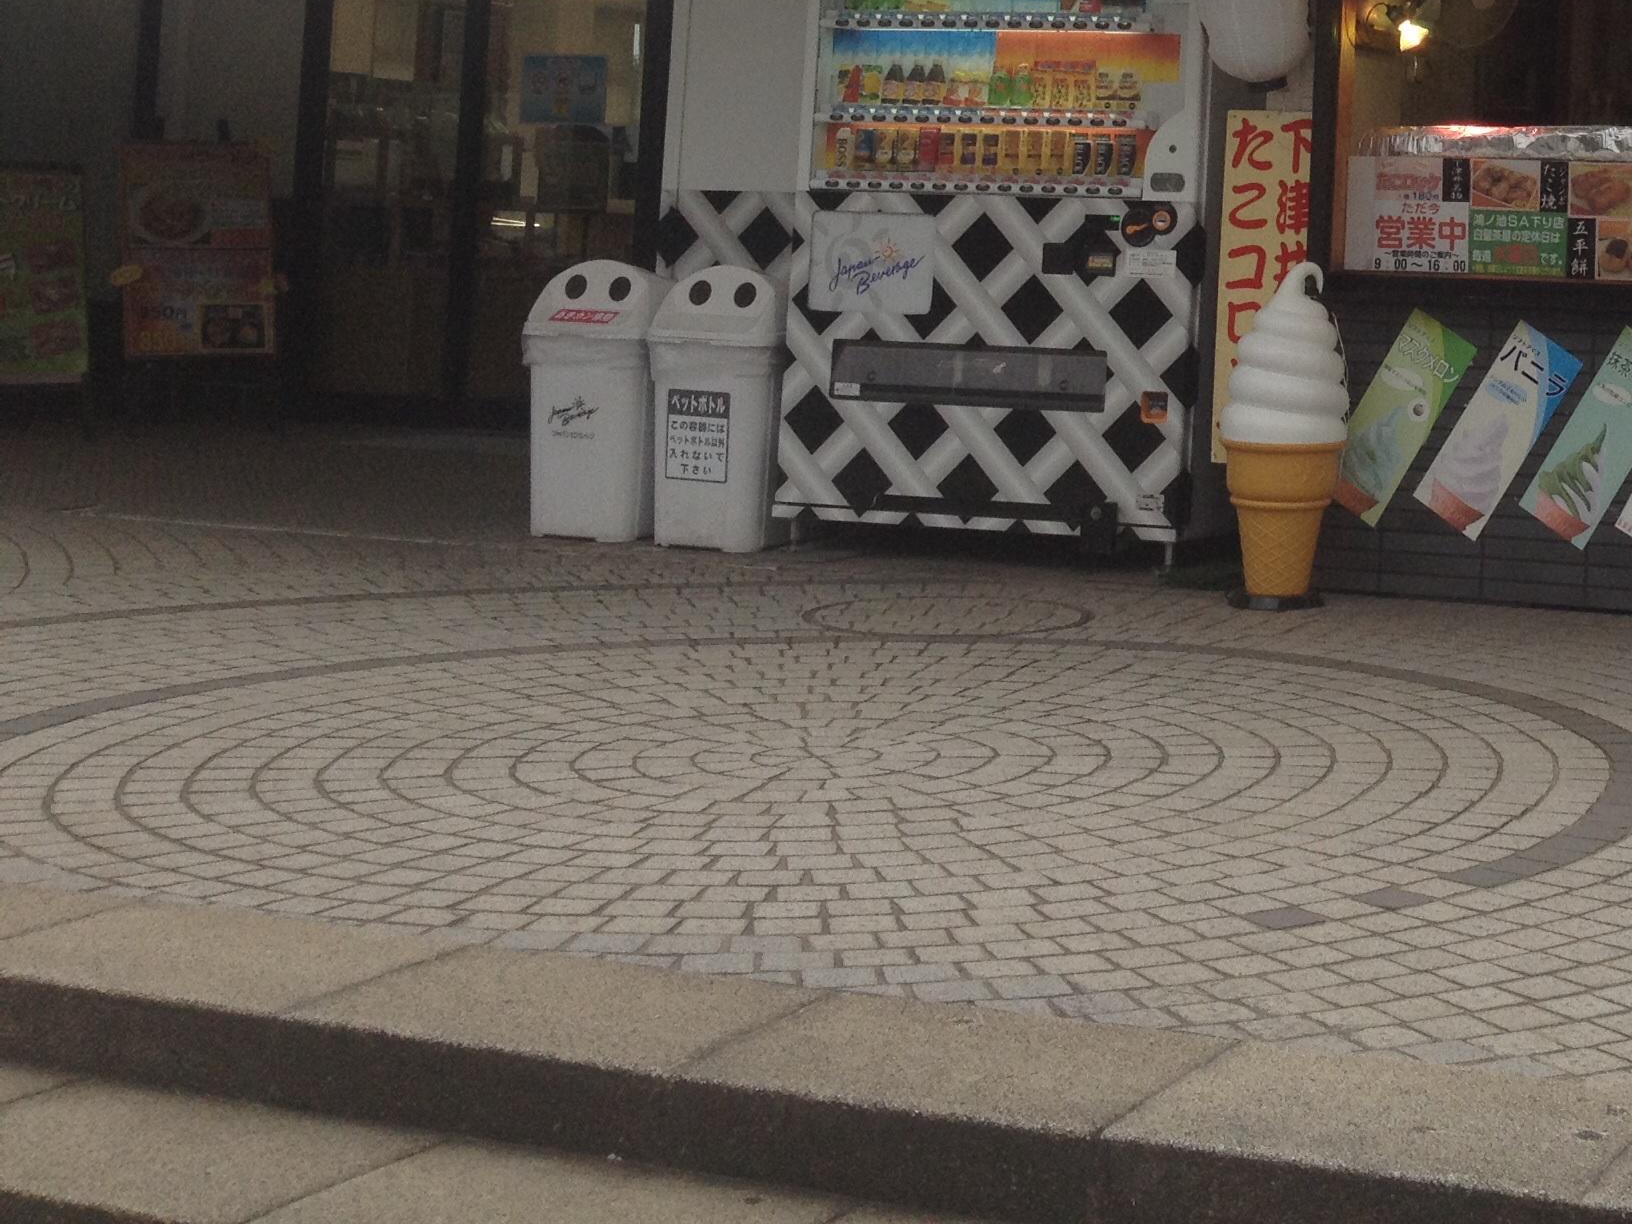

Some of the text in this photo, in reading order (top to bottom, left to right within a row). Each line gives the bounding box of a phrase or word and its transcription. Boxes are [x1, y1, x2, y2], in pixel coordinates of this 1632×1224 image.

[1401, 202, 1440, 214] ただ今
[1376, 214, 1466, 251] 営業中
[1571, 221, 1590, 277] 五平餅
[829, 256, 881, 292] Japan
[849, 255, 926, 295] Beverage
[1398, 334, 1460, 383] マスクメロン
[671, 394, 726, 414] ペットボトル
[670, 420, 725, 434] この容器には
[669, 434, 725, 449] ペットボトル以外
[669, 448, 725, 463] 入れないで
[680, 463, 712, 476] 下さい
